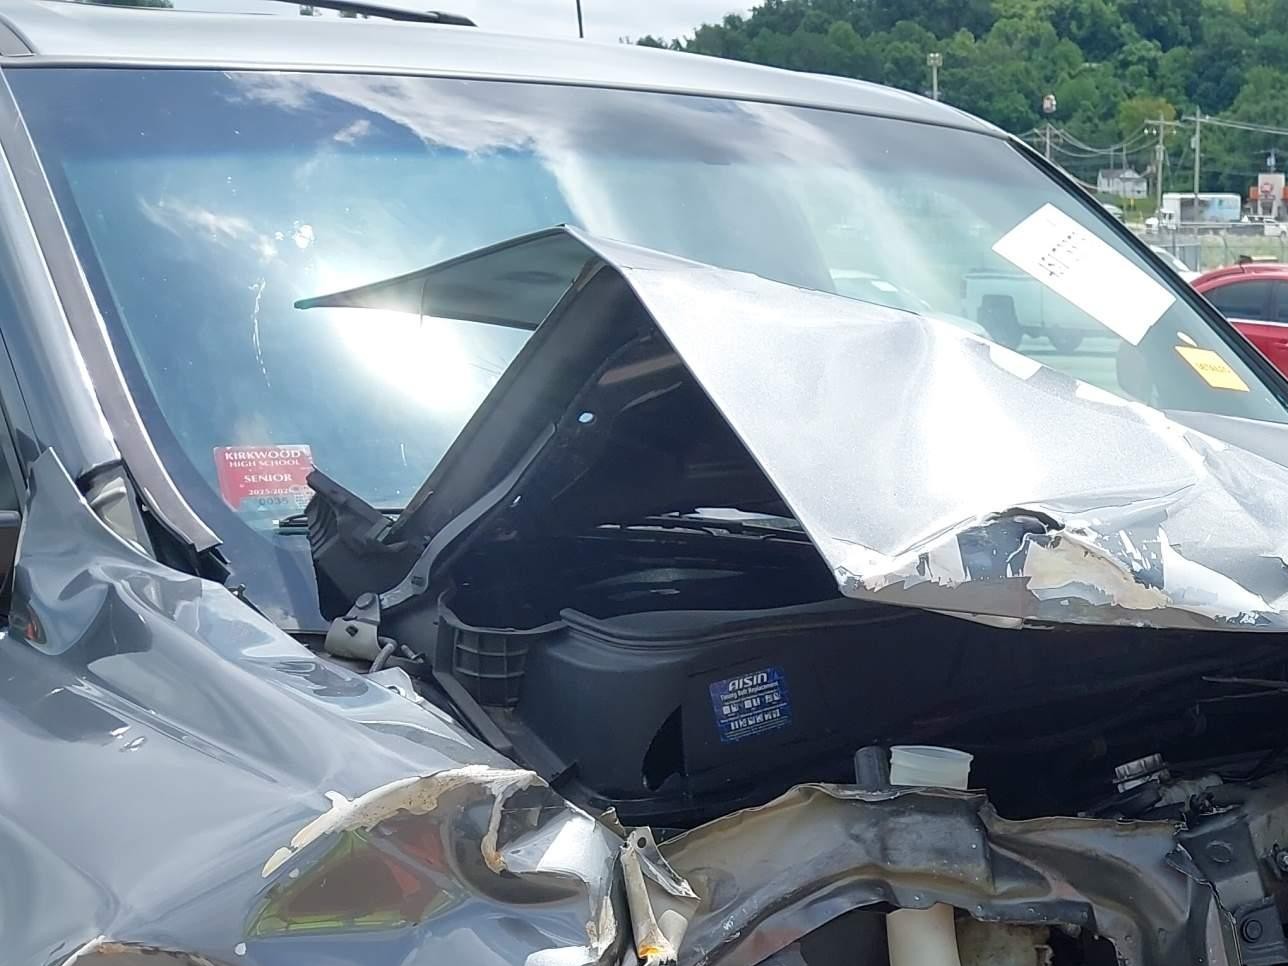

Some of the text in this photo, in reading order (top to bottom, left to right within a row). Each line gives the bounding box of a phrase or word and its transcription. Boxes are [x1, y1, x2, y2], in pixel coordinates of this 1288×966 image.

[225, 450, 301, 460] KIRKWOOD
[229, 460, 256, 468] HIGH
[244, 473, 292, 483] SENIOR
[728, 672, 768, 692] AISIN
